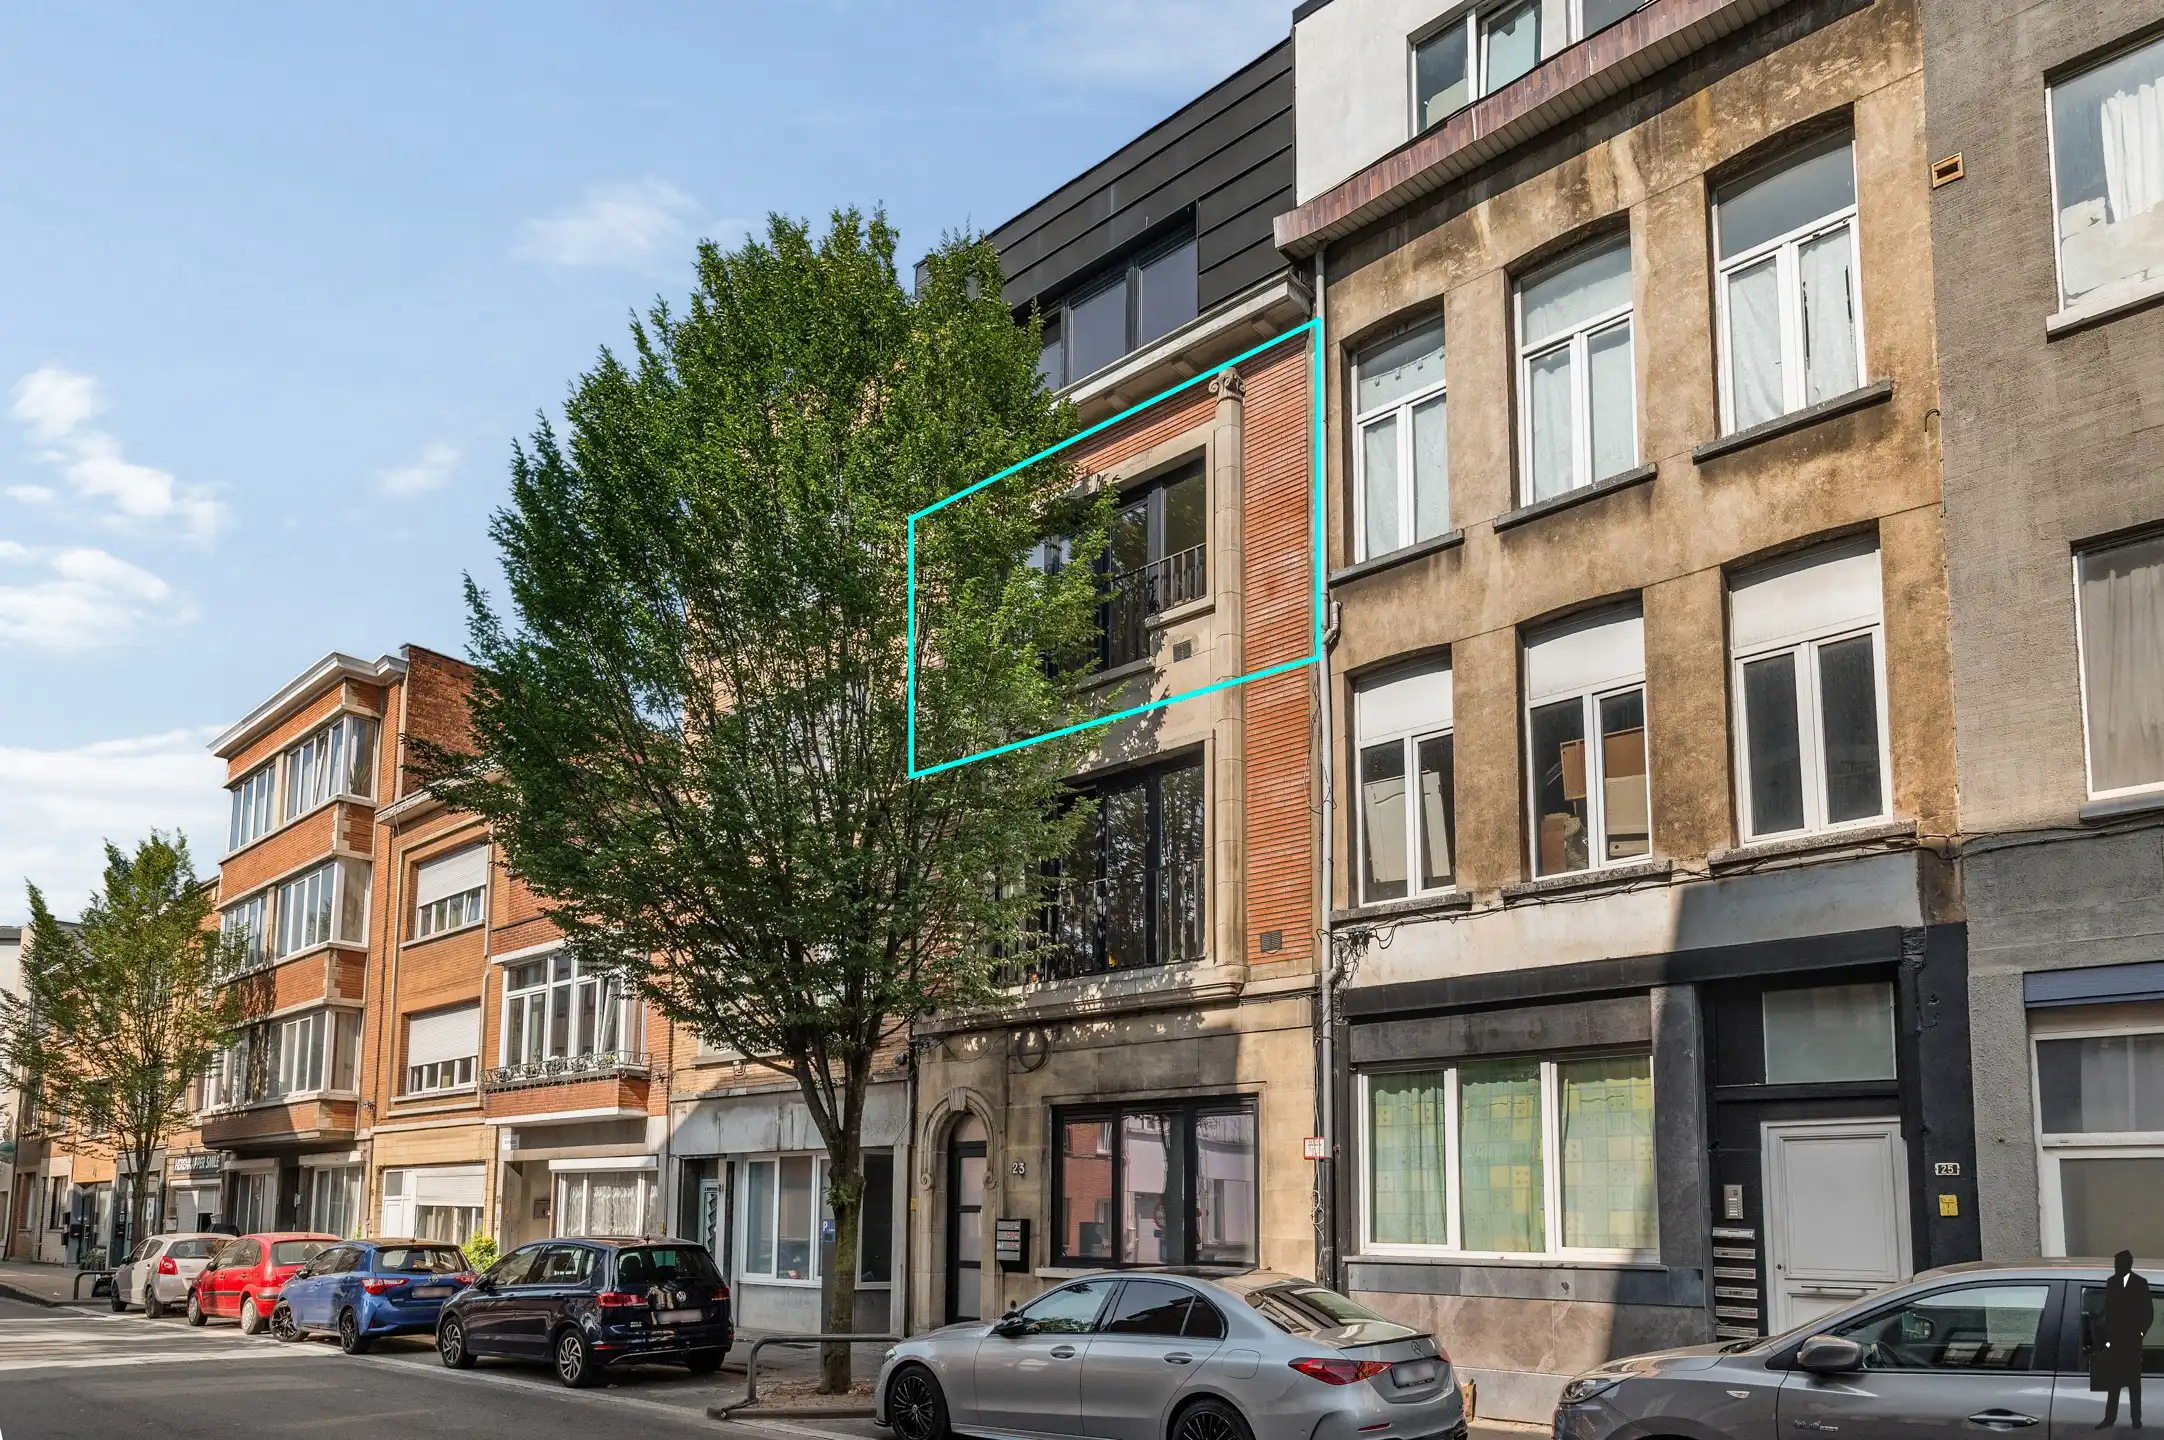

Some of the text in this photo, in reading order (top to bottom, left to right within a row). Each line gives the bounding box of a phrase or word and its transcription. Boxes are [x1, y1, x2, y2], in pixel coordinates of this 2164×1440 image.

[1012, 1162, 1025, 1174] 23
[1940, 1164, 1954, 1174] 25
[822, 1220, 828, 1232] P
